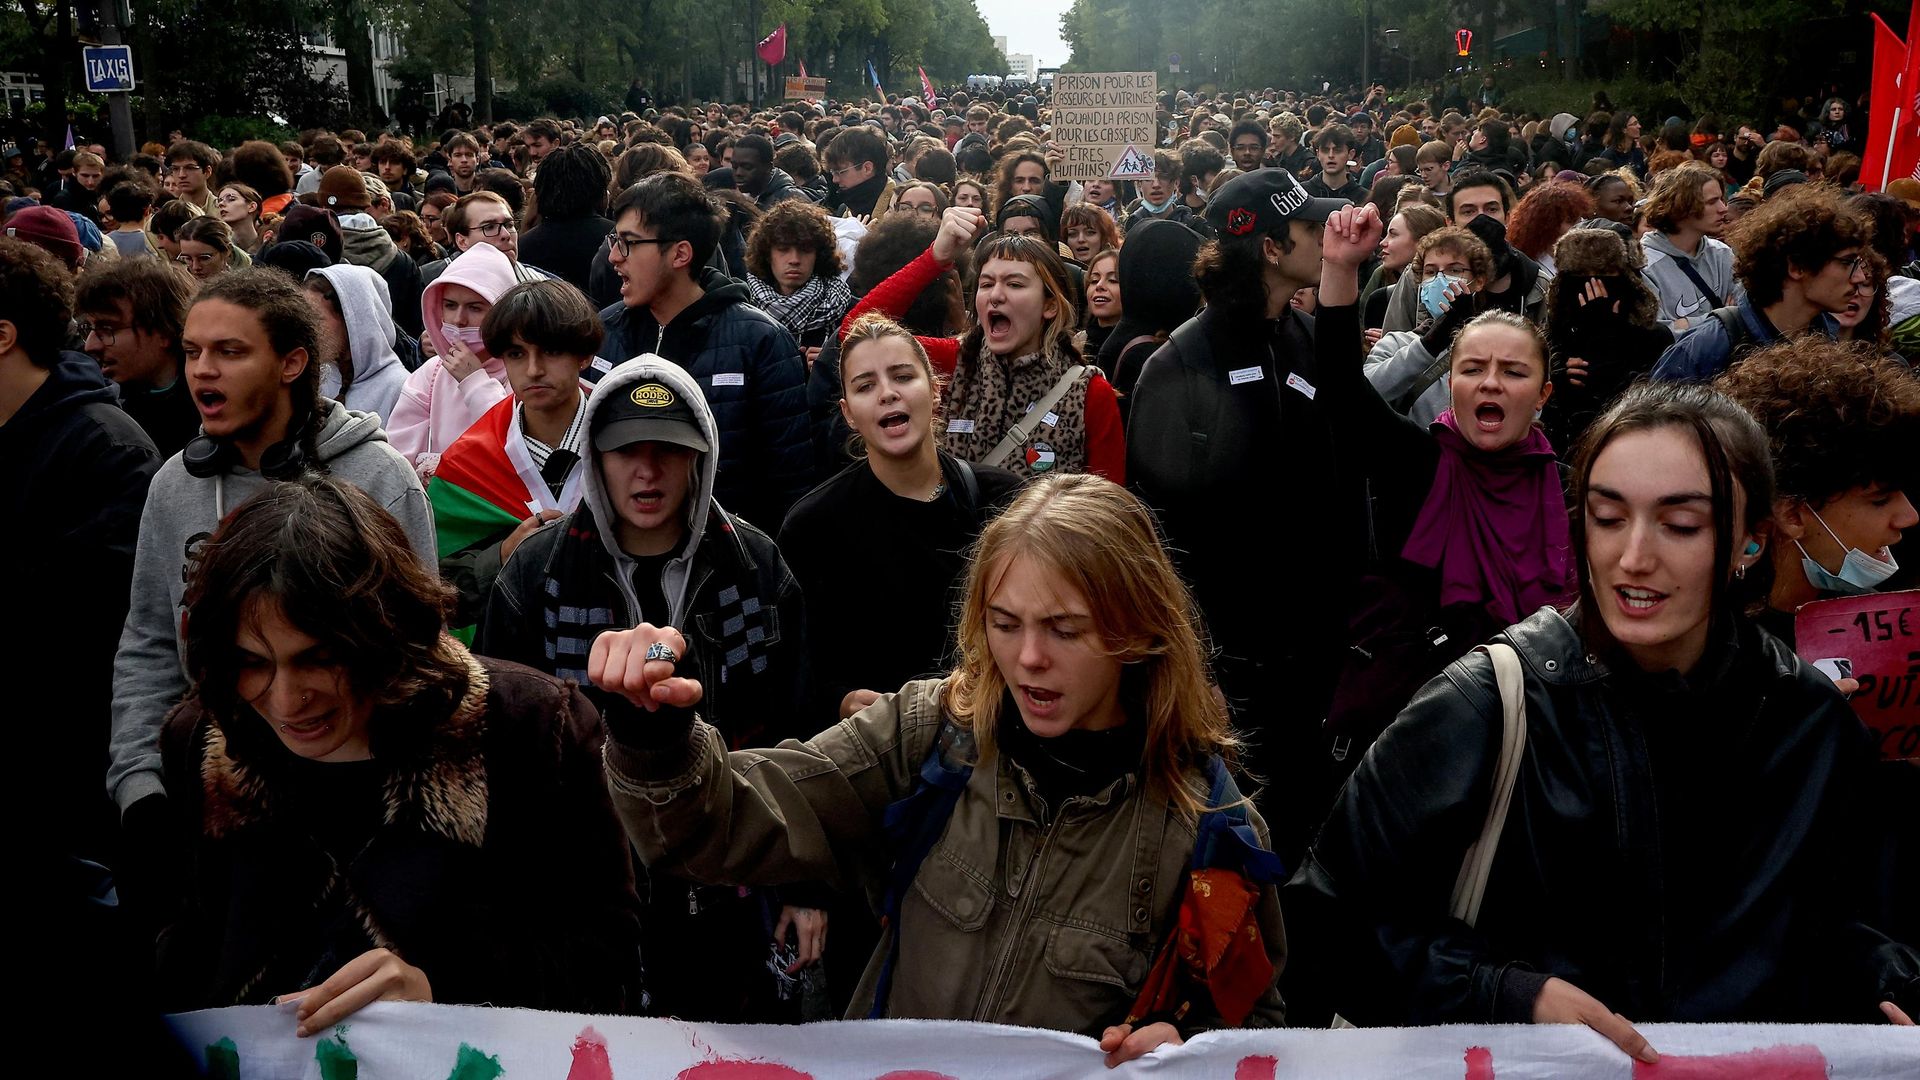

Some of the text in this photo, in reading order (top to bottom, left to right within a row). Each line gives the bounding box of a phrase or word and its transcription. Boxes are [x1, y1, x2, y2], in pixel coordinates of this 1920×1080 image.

[89, 59, 130, 82] TAXIS
[1059, 75, 1153, 90] PRISON POUR LES
[1053, 91, 1154, 106] CASSEURS DE VITRINES
[1065, 111, 1101, 125] QUAND
[1103, 112, 1113, 125] LA
[1117, 111, 1154, 125] PRISON
[1056, 128, 1149, 143] POUR LES CASSEURS
[1063, 144, 1103, 162] 'ÊTRES
[1054, 161, 1112, 177] HUMAINS?
[636, 391, 669, 401] RODEO
